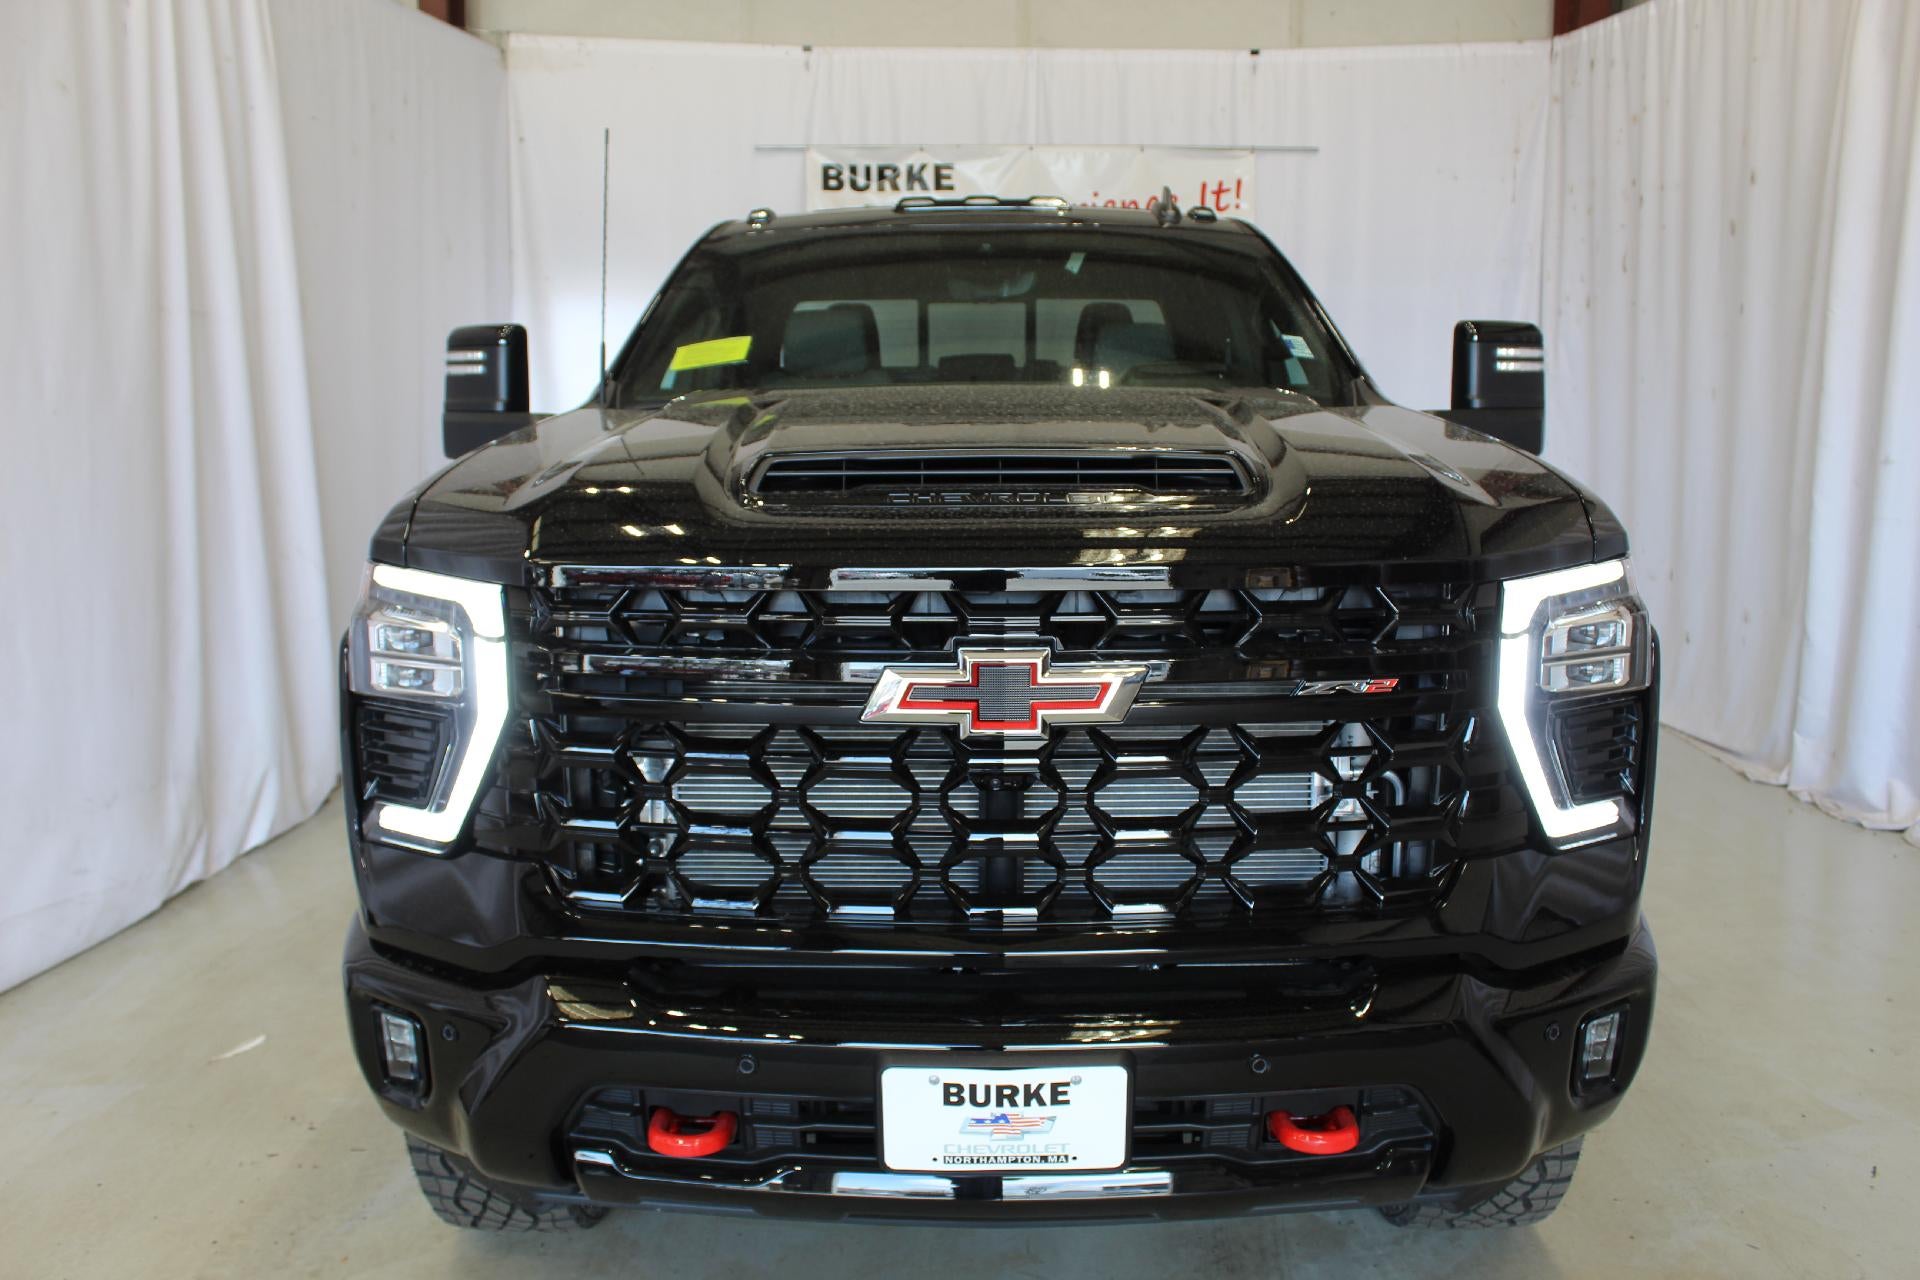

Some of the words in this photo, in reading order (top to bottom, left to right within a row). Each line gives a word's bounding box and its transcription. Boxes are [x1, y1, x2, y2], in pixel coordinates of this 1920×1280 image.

[822, 163, 955, 192] BURKE
[1200, 178, 1242, 212] It!
[887, 492, 1114, 504] CHEVROLET
[942, 1082, 1071, 1107] BURKE
[943, 1143, 1071, 1154] CHEVROLET
[1047, 1155, 1068, 1163] MA
